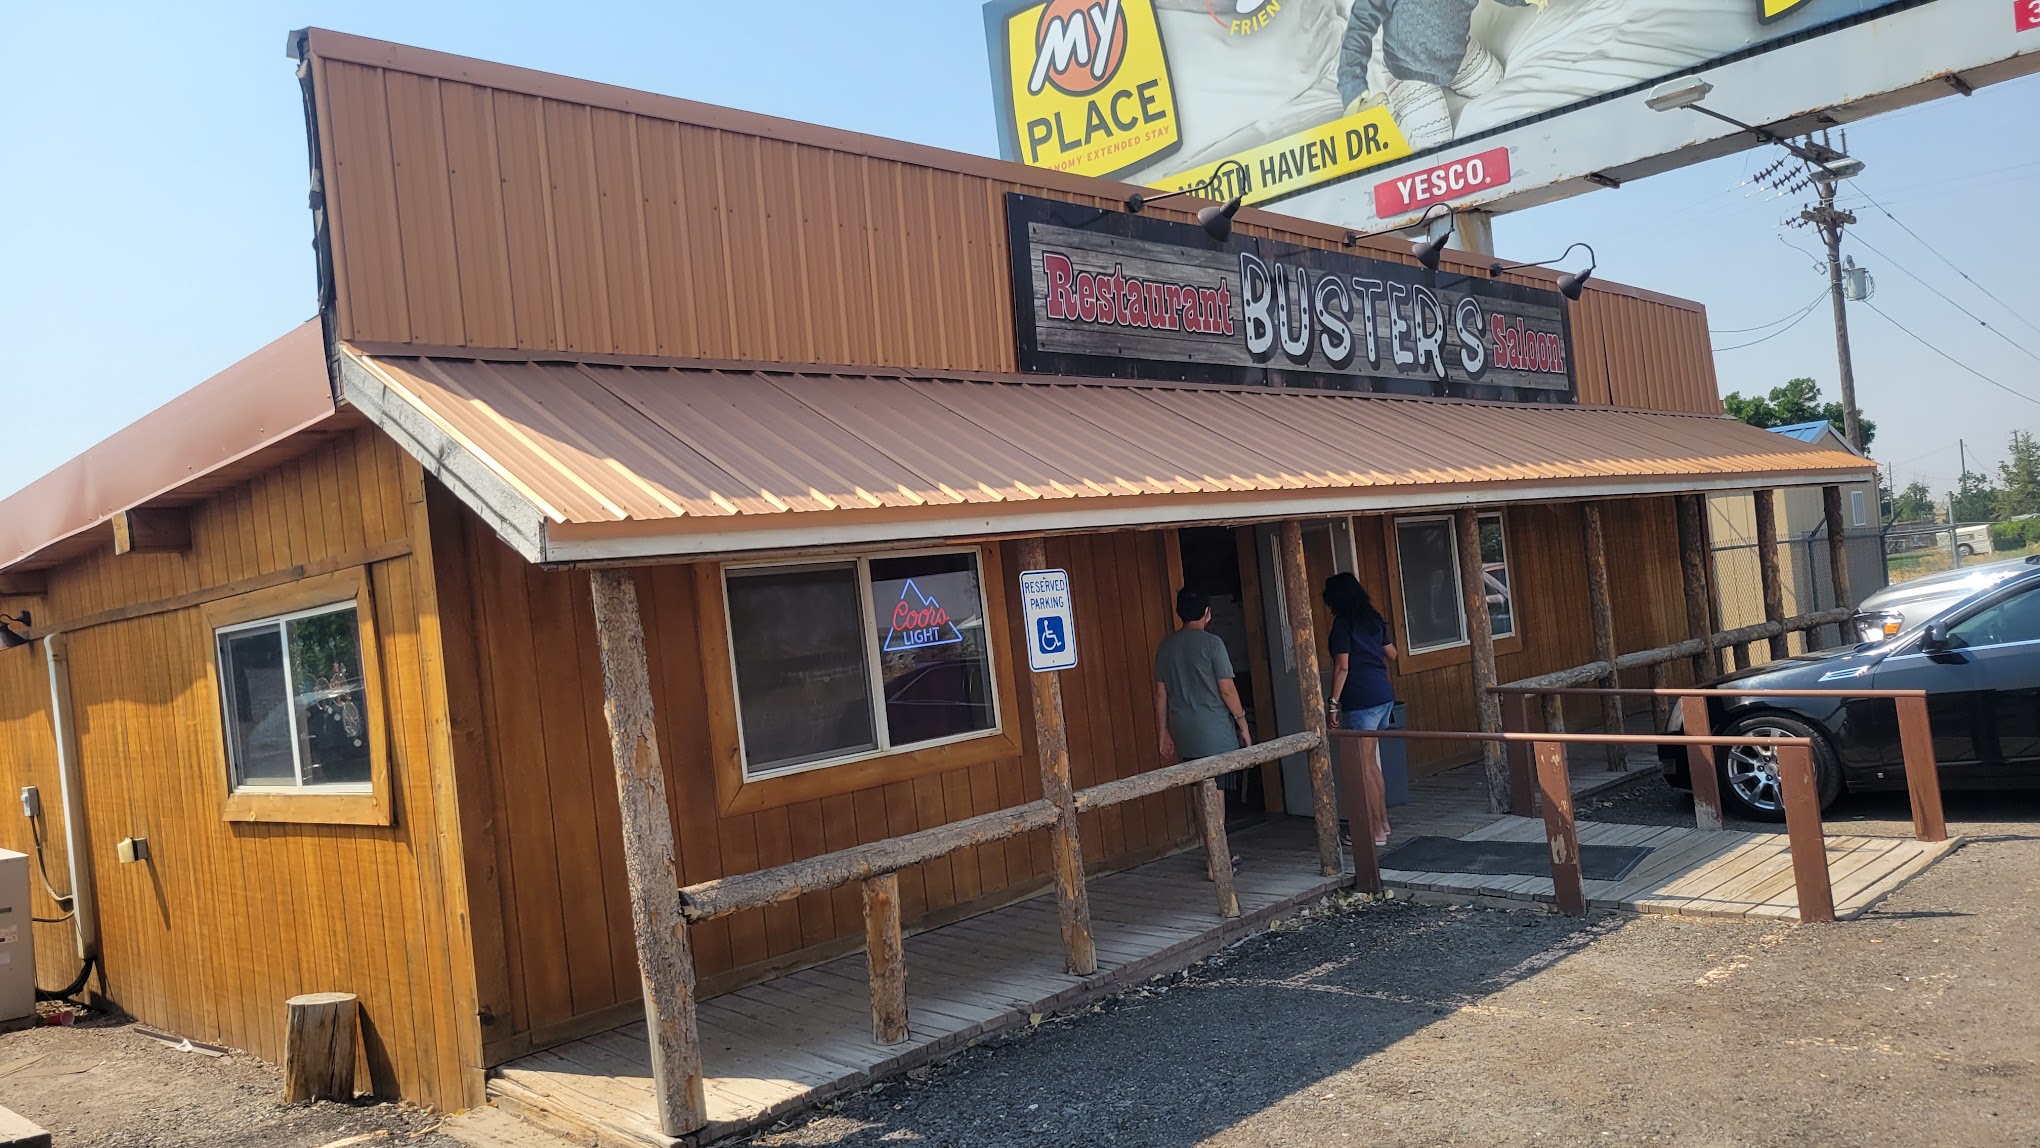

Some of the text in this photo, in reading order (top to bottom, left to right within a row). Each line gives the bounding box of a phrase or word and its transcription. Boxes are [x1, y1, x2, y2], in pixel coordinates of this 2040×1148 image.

[1027, 79, 1167, 163] PLACE
[1087, 136, 1141, 162] EXTENDED
[1145, 125, 1170, 141] STAY
[1259, 135, 1339, 188] HAVEN
[1345, 122, 1389, 161] DR.
[1043, 252, 1235, 336] Restaurant
[1491, 313, 1565, 374] Saloon
[1024, 579, 1065, 594] RESERVED
[1030, 596, 1064, 610] PARKING
[893, 601, 949, 632] Coors
[903, 627, 939, 645] LIGHT
